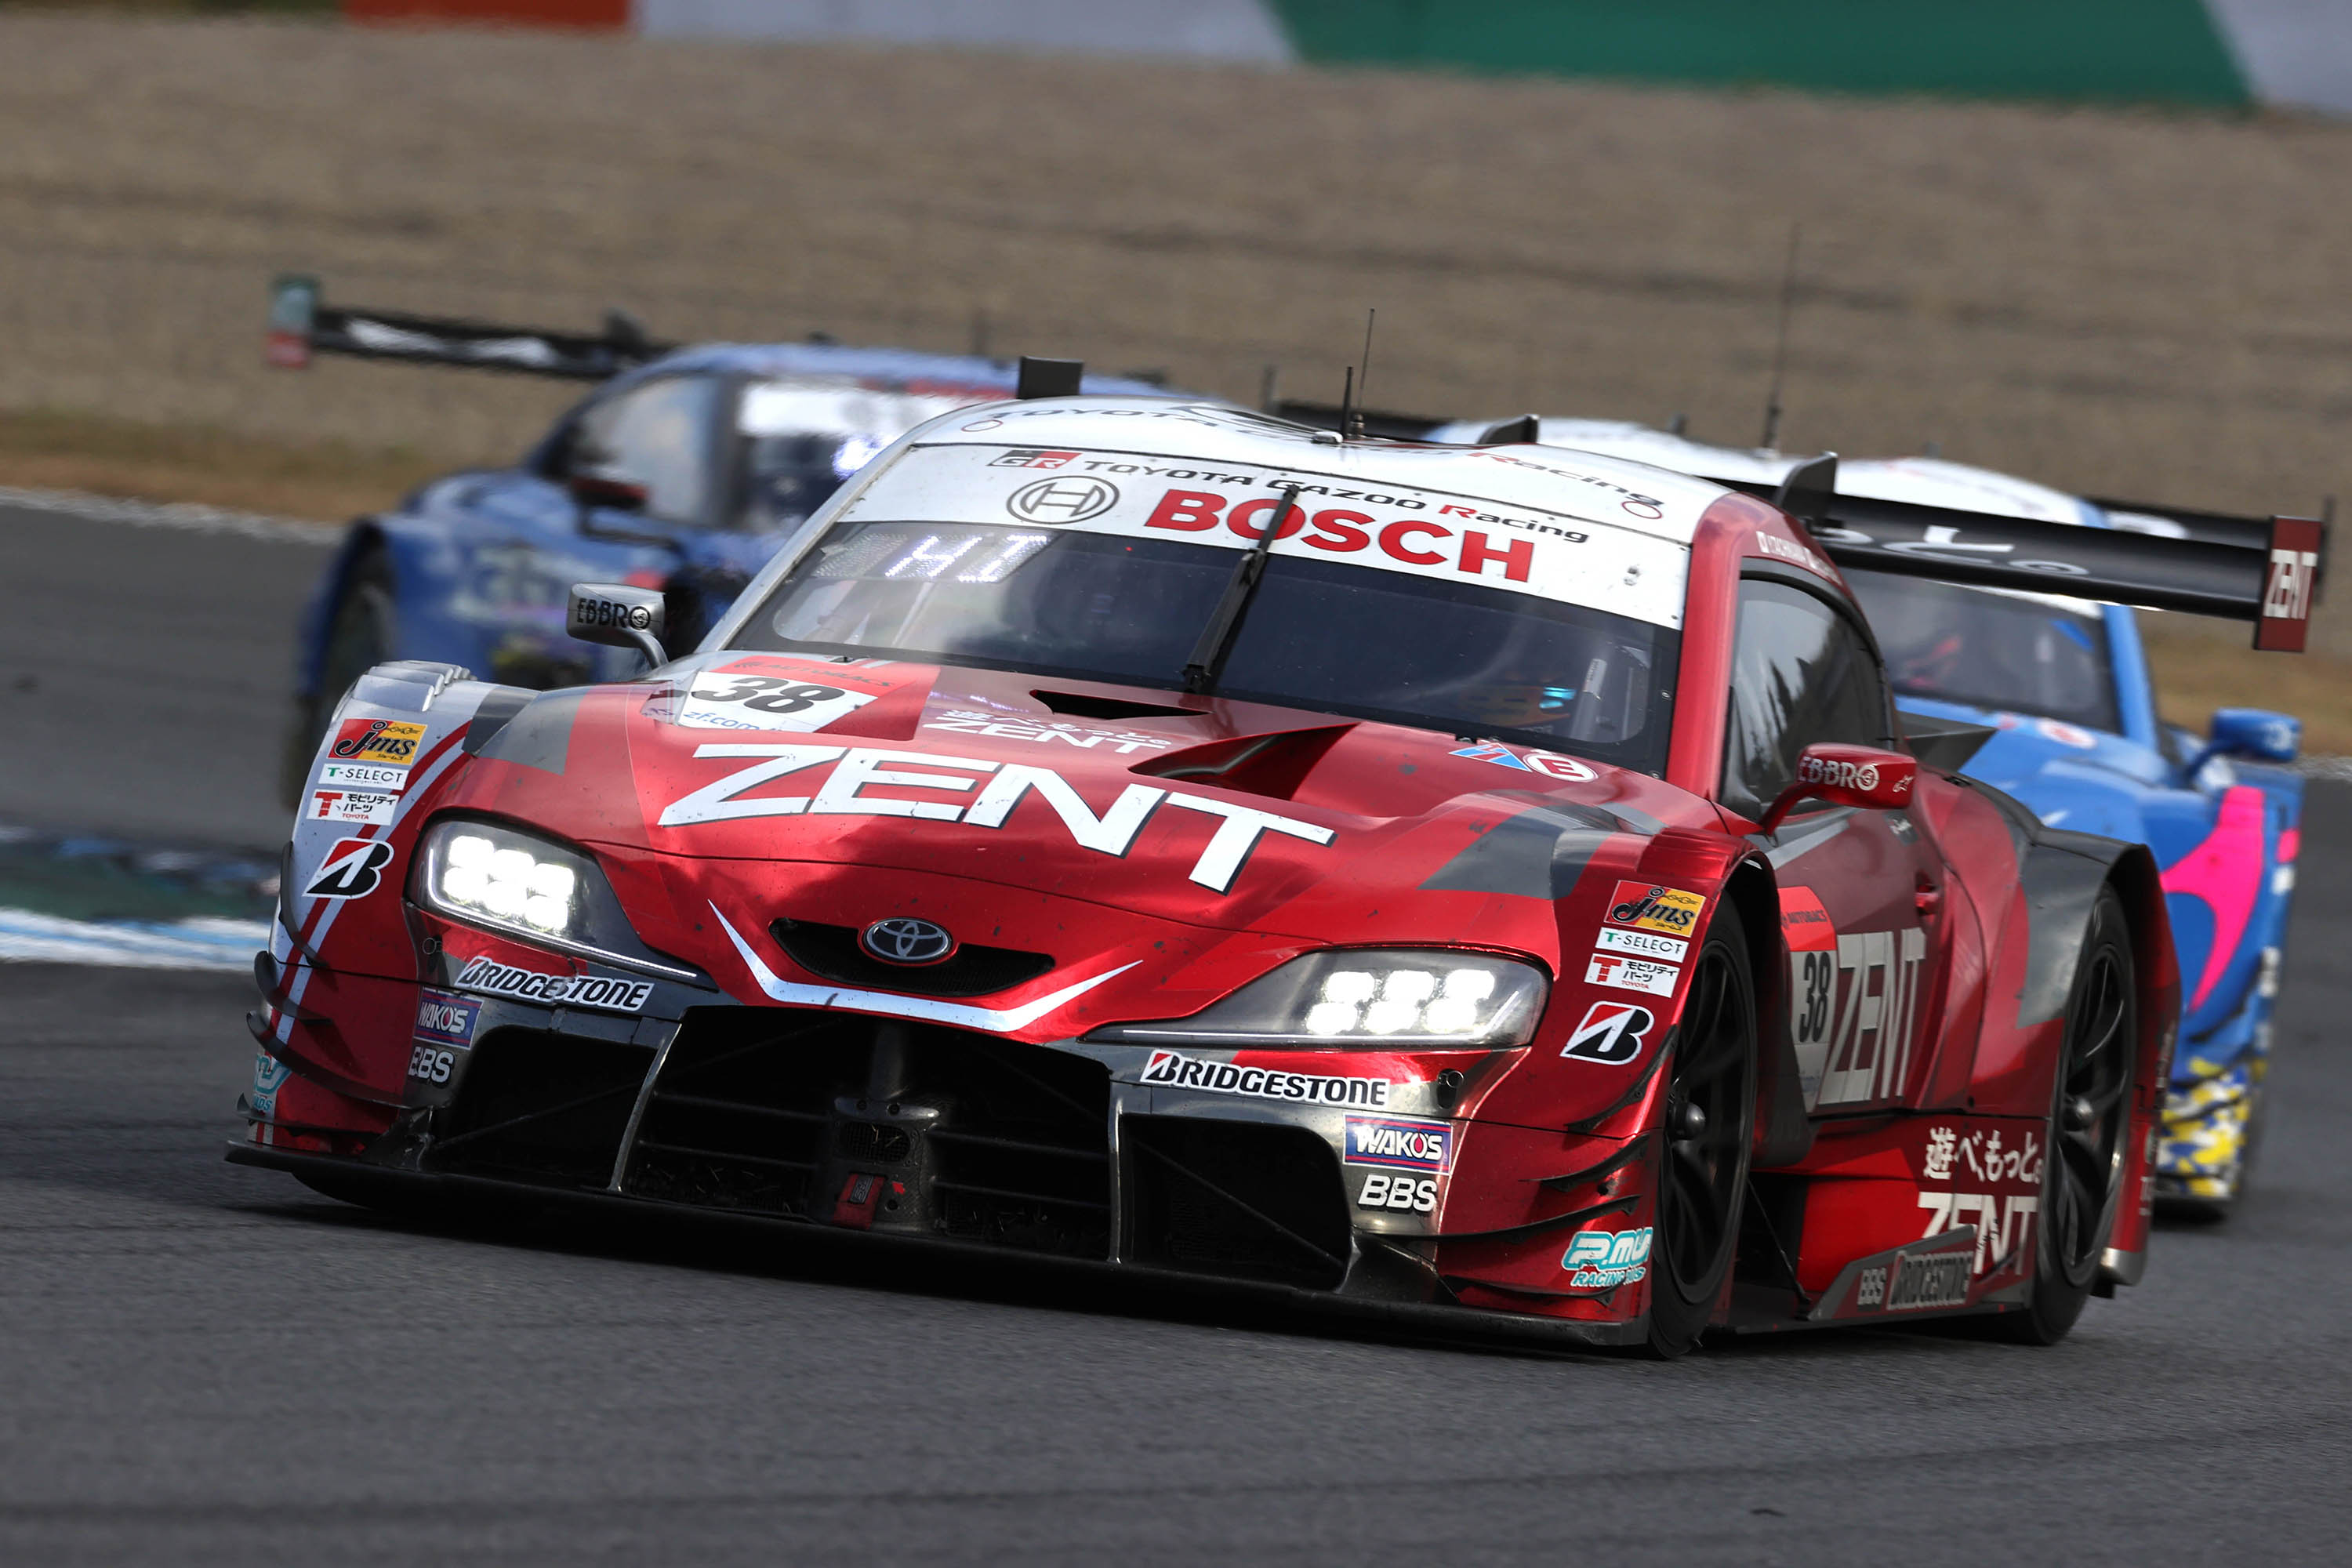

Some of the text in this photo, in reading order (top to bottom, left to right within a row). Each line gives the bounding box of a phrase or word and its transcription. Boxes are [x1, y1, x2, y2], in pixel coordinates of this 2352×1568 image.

[1467, 452, 1664, 507] Racing
[1084, 460, 1589, 543] TOYOTA GAZOO Racing
[1145, 488, 1534, 583] BOSCH
[2263, 549, 2318, 619] ZENT
[576, 598, 651, 630] EBBRO
[691, 677, 845, 714] 38
[923, 717, 1167, 754] ZENT
[328, 767, 403, 783] T-SELECT
[1798, 755, 1879, 791] EBBRO
[343, 803, 373, 813] パーツ
[347, 793, 396, 805] モビリティ
[657, 744, 1338, 895] ZENT
[1605, 931, 1682, 954] T-SELECT
[459, 956, 651, 1009] BRIDGESTONE
[1621, 979, 1650, 989] TOYOTA
[1623, 971, 1653, 982] パーツ
[1627, 960, 1678, 976] モビリティ
[1799, 952, 1831, 1043] 38
[1817, 927, 1926, 1104] ZENT
[408, 1047, 455, 1083] BBS
[1145, 1051, 1387, 1107] BRIDGESTONE
[1359, 1174, 1438, 1213] BBS
